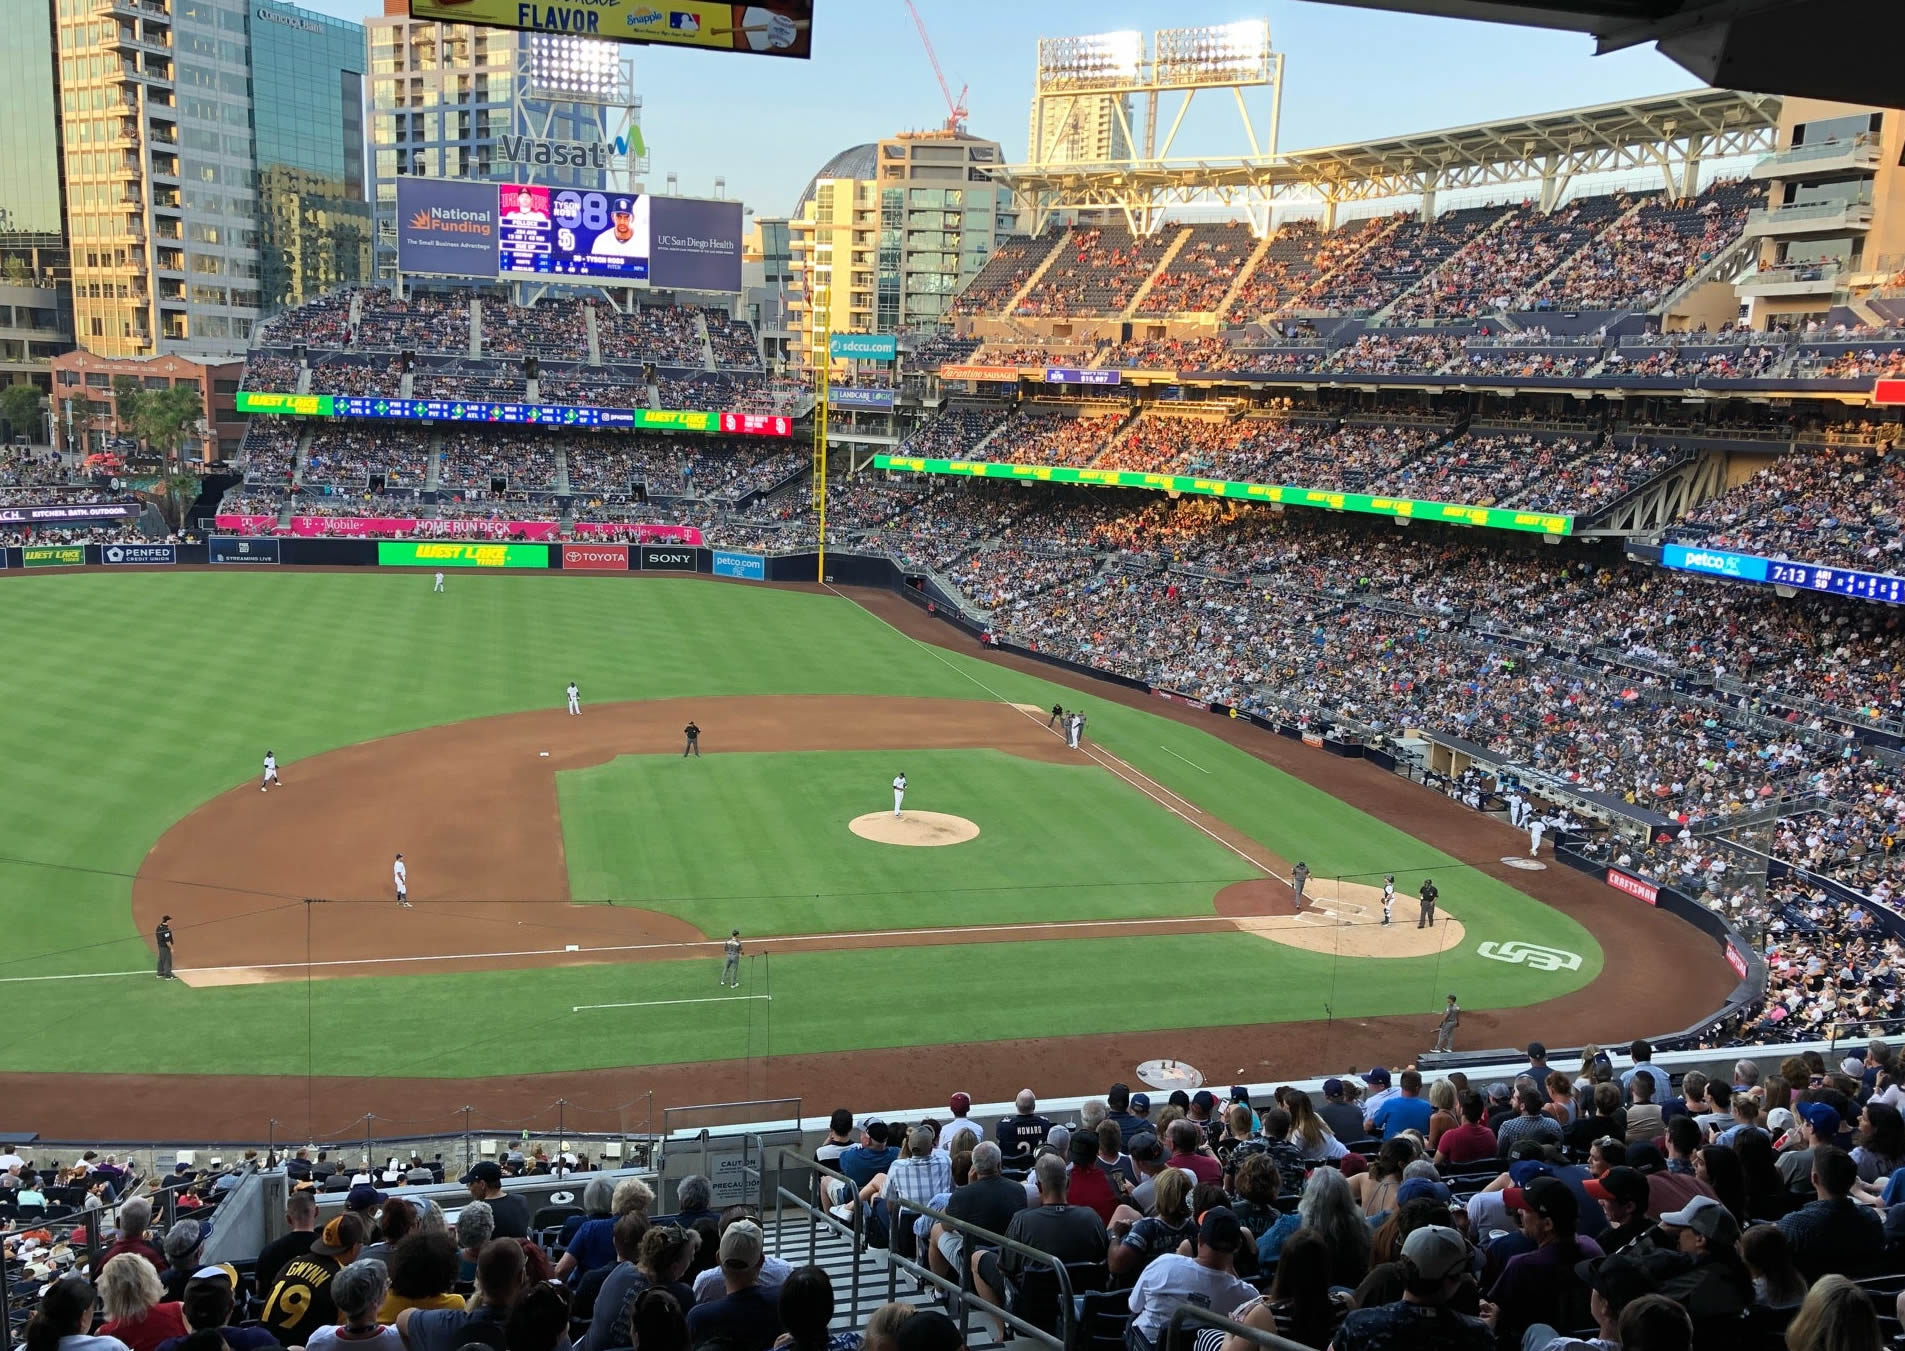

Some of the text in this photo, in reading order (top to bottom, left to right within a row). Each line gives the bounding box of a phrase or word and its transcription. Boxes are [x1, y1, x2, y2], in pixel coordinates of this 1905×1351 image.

[518, 3, 599, 33] FLAVOR
[627, 11, 662, 26] Snapple
[502, 134, 604, 168] Viasat
[553, 201, 580, 210] TYSON
[431, 207, 491, 222] National
[431, 219, 491, 236] Funding
[419, 239, 434, 247] Small
[436, 240, 459, 248] Business
[460, 241, 490, 251] Advantage
[658, 235, 734, 249] UC San Diego Health
[842, 340, 892, 353] sdccu.com
[942, 367, 1016, 379] Tarantino SAUSAGES
[248, 394, 320, 408] WEST LAKE
[839, 391, 892, 400] LANDCARE LOGIC
[645, 411, 708, 424] WEST LAKE
[32, 510, 67, 518] KITCHEN.
[90, 508, 127, 516] OUTDOOR.
[416, 520, 511, 533] HOME RUN DECK
[25, 550, 81, 560] WEST LAKE
[126, 548, 170, 557] PENFED
[415, 544, 508, 560] WEST LAKE
[583, 554, 625, 562] TOYOTA
[649, 554, 690, 563] SONY
[476, 558, 505, 567] TIRES
[716, 556, 760, 569] petco.com
[1685, 552, 1724, 569] petco
[1773, 566, 1806, 584] 7:13
[1816, 570, 1832, 580] ARI
[1880, 584, 1887, 593] E
[1815, 579, 1828, 589] SD
[1609, 873, 1657, 903] CRAFTSMAN
[1017, 1125, 1042, 1135] HOWARD
[285, 1261, 331, 1288] GWYNN
[261, 1280, 312, 1329] 19
